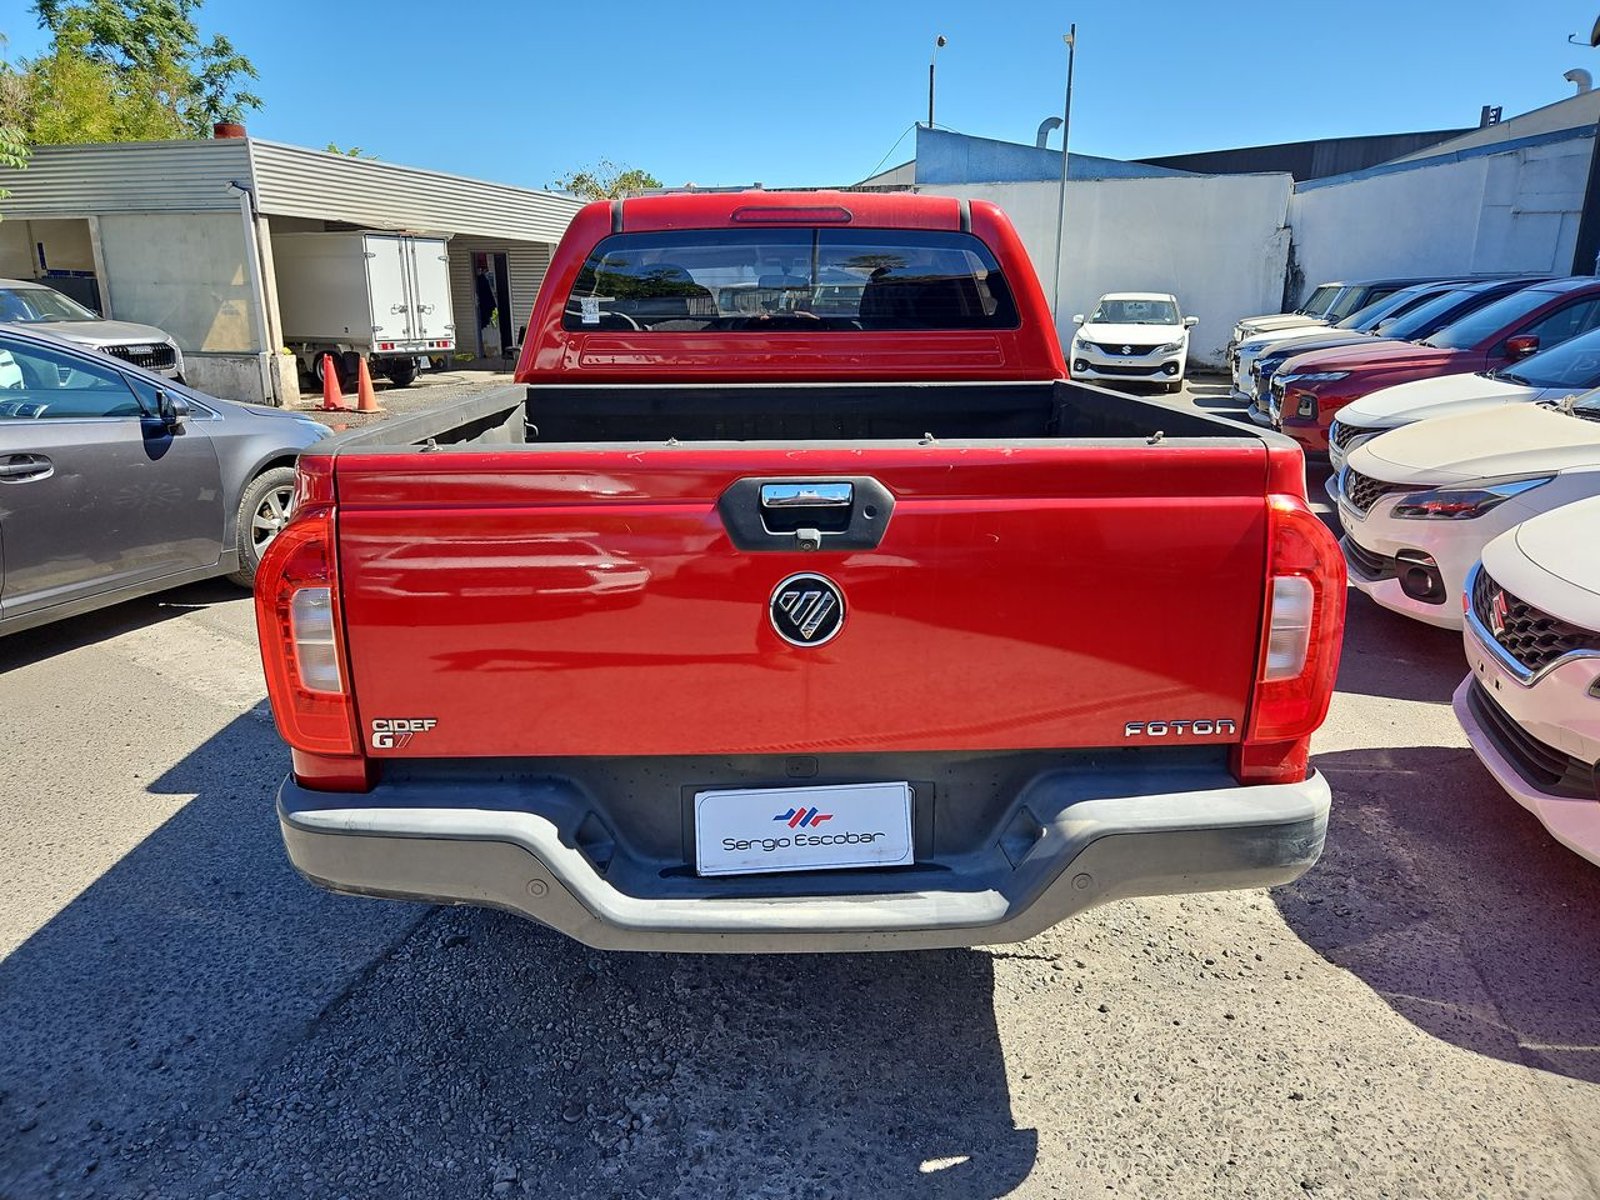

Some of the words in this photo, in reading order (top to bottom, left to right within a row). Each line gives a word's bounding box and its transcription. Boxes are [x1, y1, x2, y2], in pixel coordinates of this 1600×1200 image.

[372, 719, 437, 731] CIDEF
[722, 837, 791, 852] Sergio
[794, 831, 886, 847] Escobar
